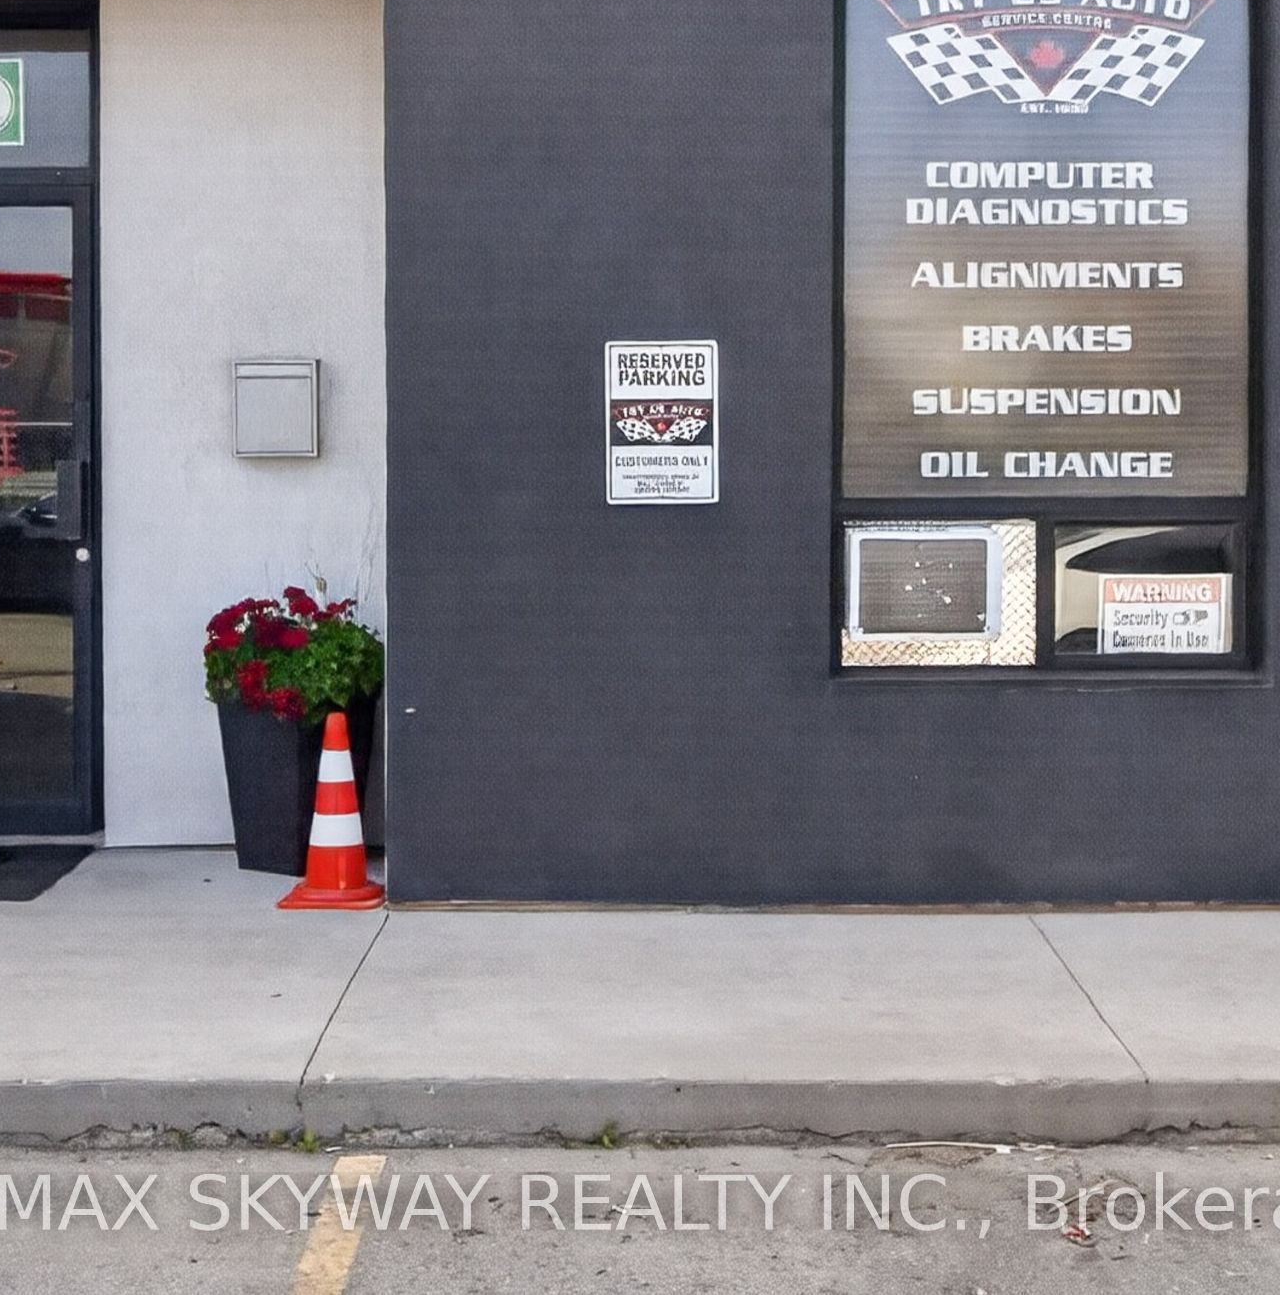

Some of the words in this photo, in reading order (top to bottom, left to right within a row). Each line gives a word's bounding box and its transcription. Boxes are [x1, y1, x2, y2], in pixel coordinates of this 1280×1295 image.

[926, 161, 1154, 189] COMPUTER
[906, 198, 1189, 225] DIAGNOSTICS
[911, 262, 1184, 288] ALIGNMENTS
[962, 325, 1132, 352] BRAKES
[618, 353, 706, 369] RESERVED
[618, 370, 706, 386] PARKING
[913, 388, 1181, 415] SUSPENSION
[920, 451, 989, 477] OIL
[1004, 451, 1174, 478] CHANGE
[1112, 582, 1213, 601] WARNING
[1113, 609, 1168, 629] Security
[1187, 630, 1209, 647] Use
